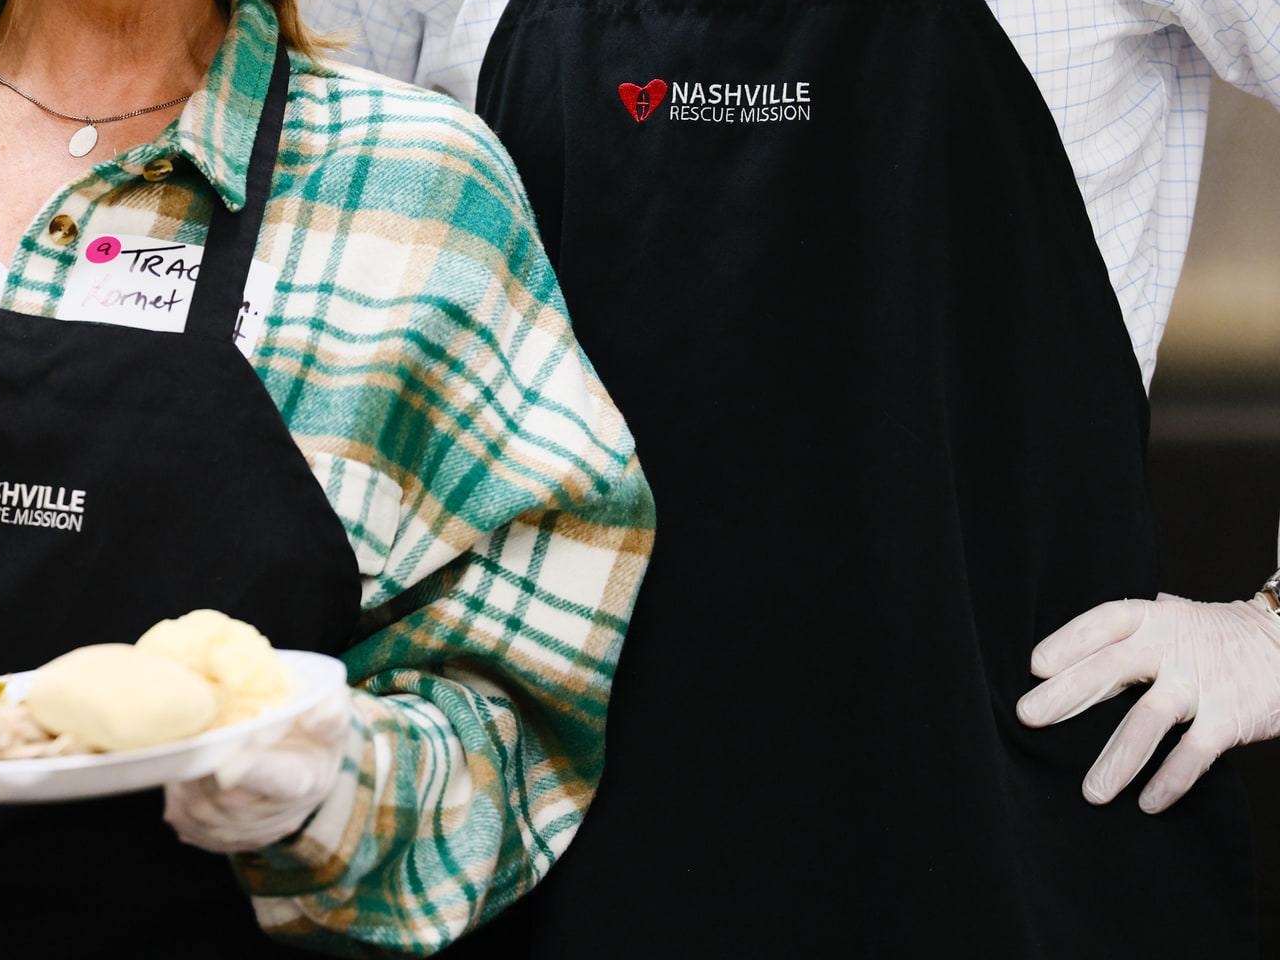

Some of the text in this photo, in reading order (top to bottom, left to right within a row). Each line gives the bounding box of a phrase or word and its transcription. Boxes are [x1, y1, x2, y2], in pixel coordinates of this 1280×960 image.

[671, 82, 811, 106] NASHVILLE
[670, 105, 811, 123] RESCUE MISSION
[13, 508, 84, 532] MISSION
